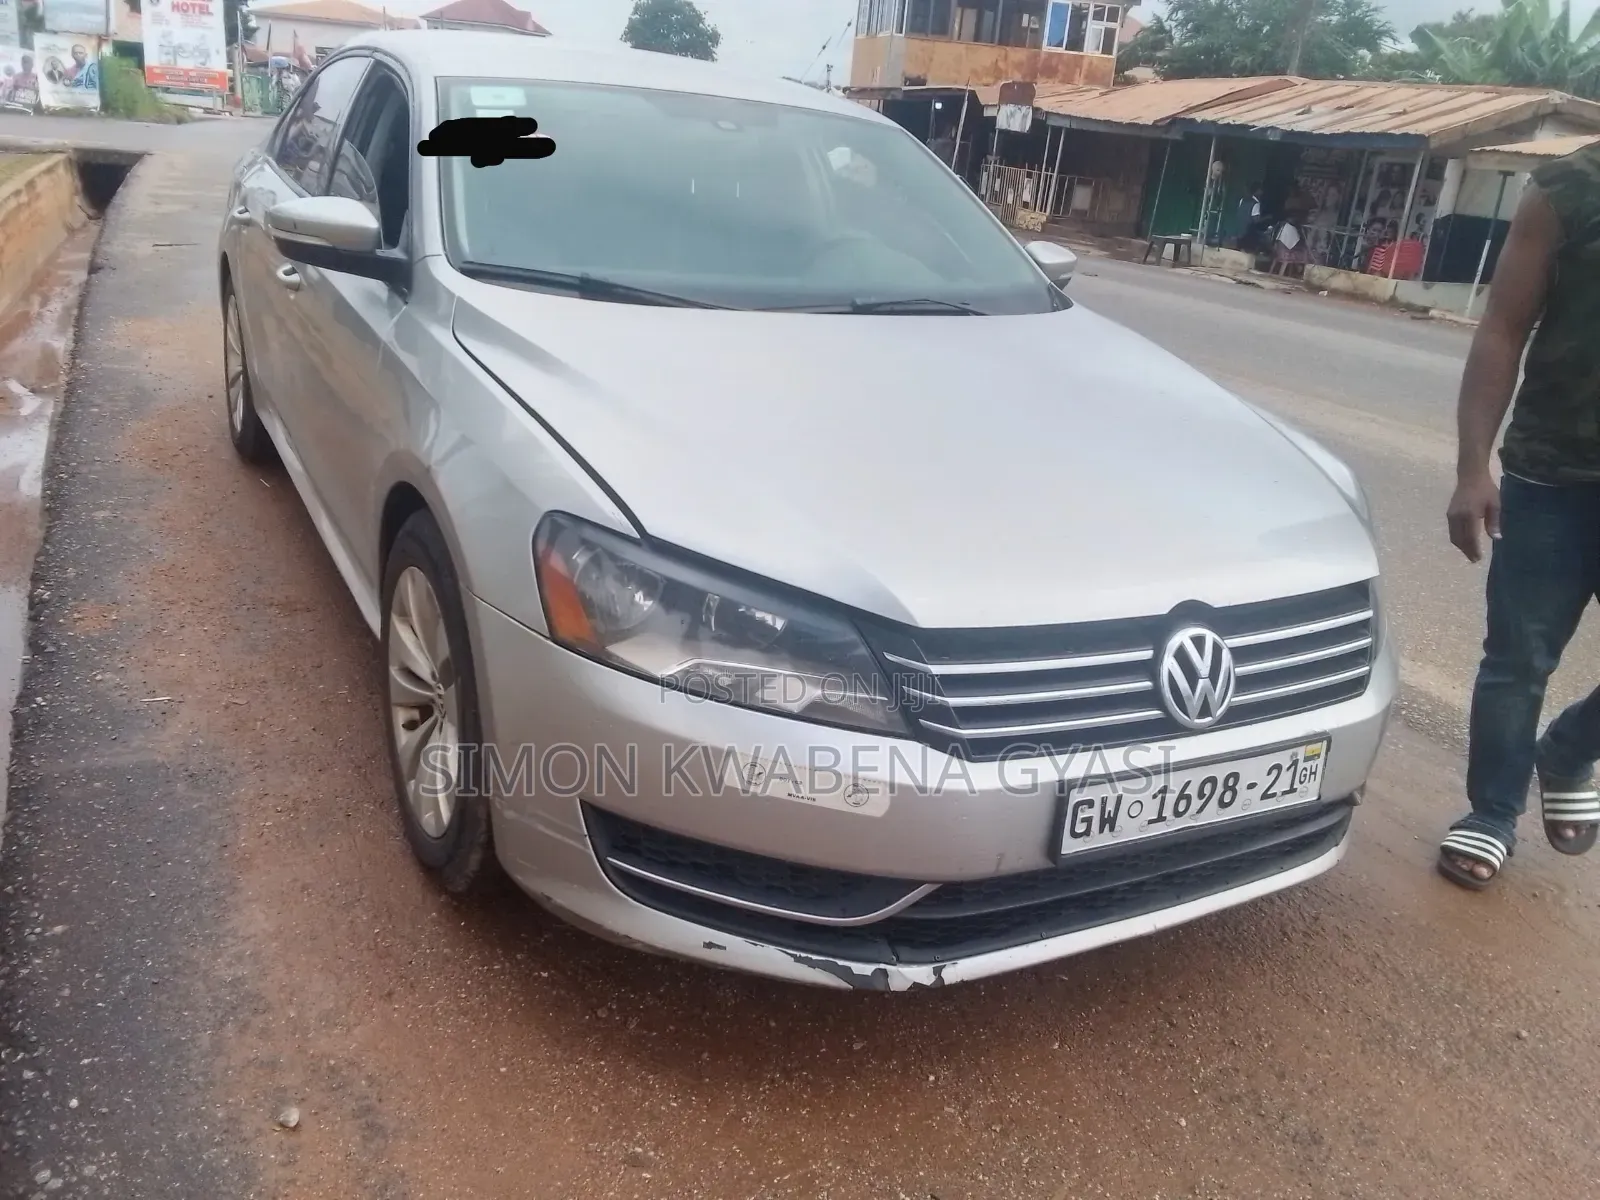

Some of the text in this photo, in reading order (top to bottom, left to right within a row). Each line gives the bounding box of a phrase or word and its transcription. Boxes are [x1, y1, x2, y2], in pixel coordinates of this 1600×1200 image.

[171, 1, 213, 15] HOTEL
[1298, 764, 1318, 785] GH
[1069, 758, 1298, 839] GW 1698-21
